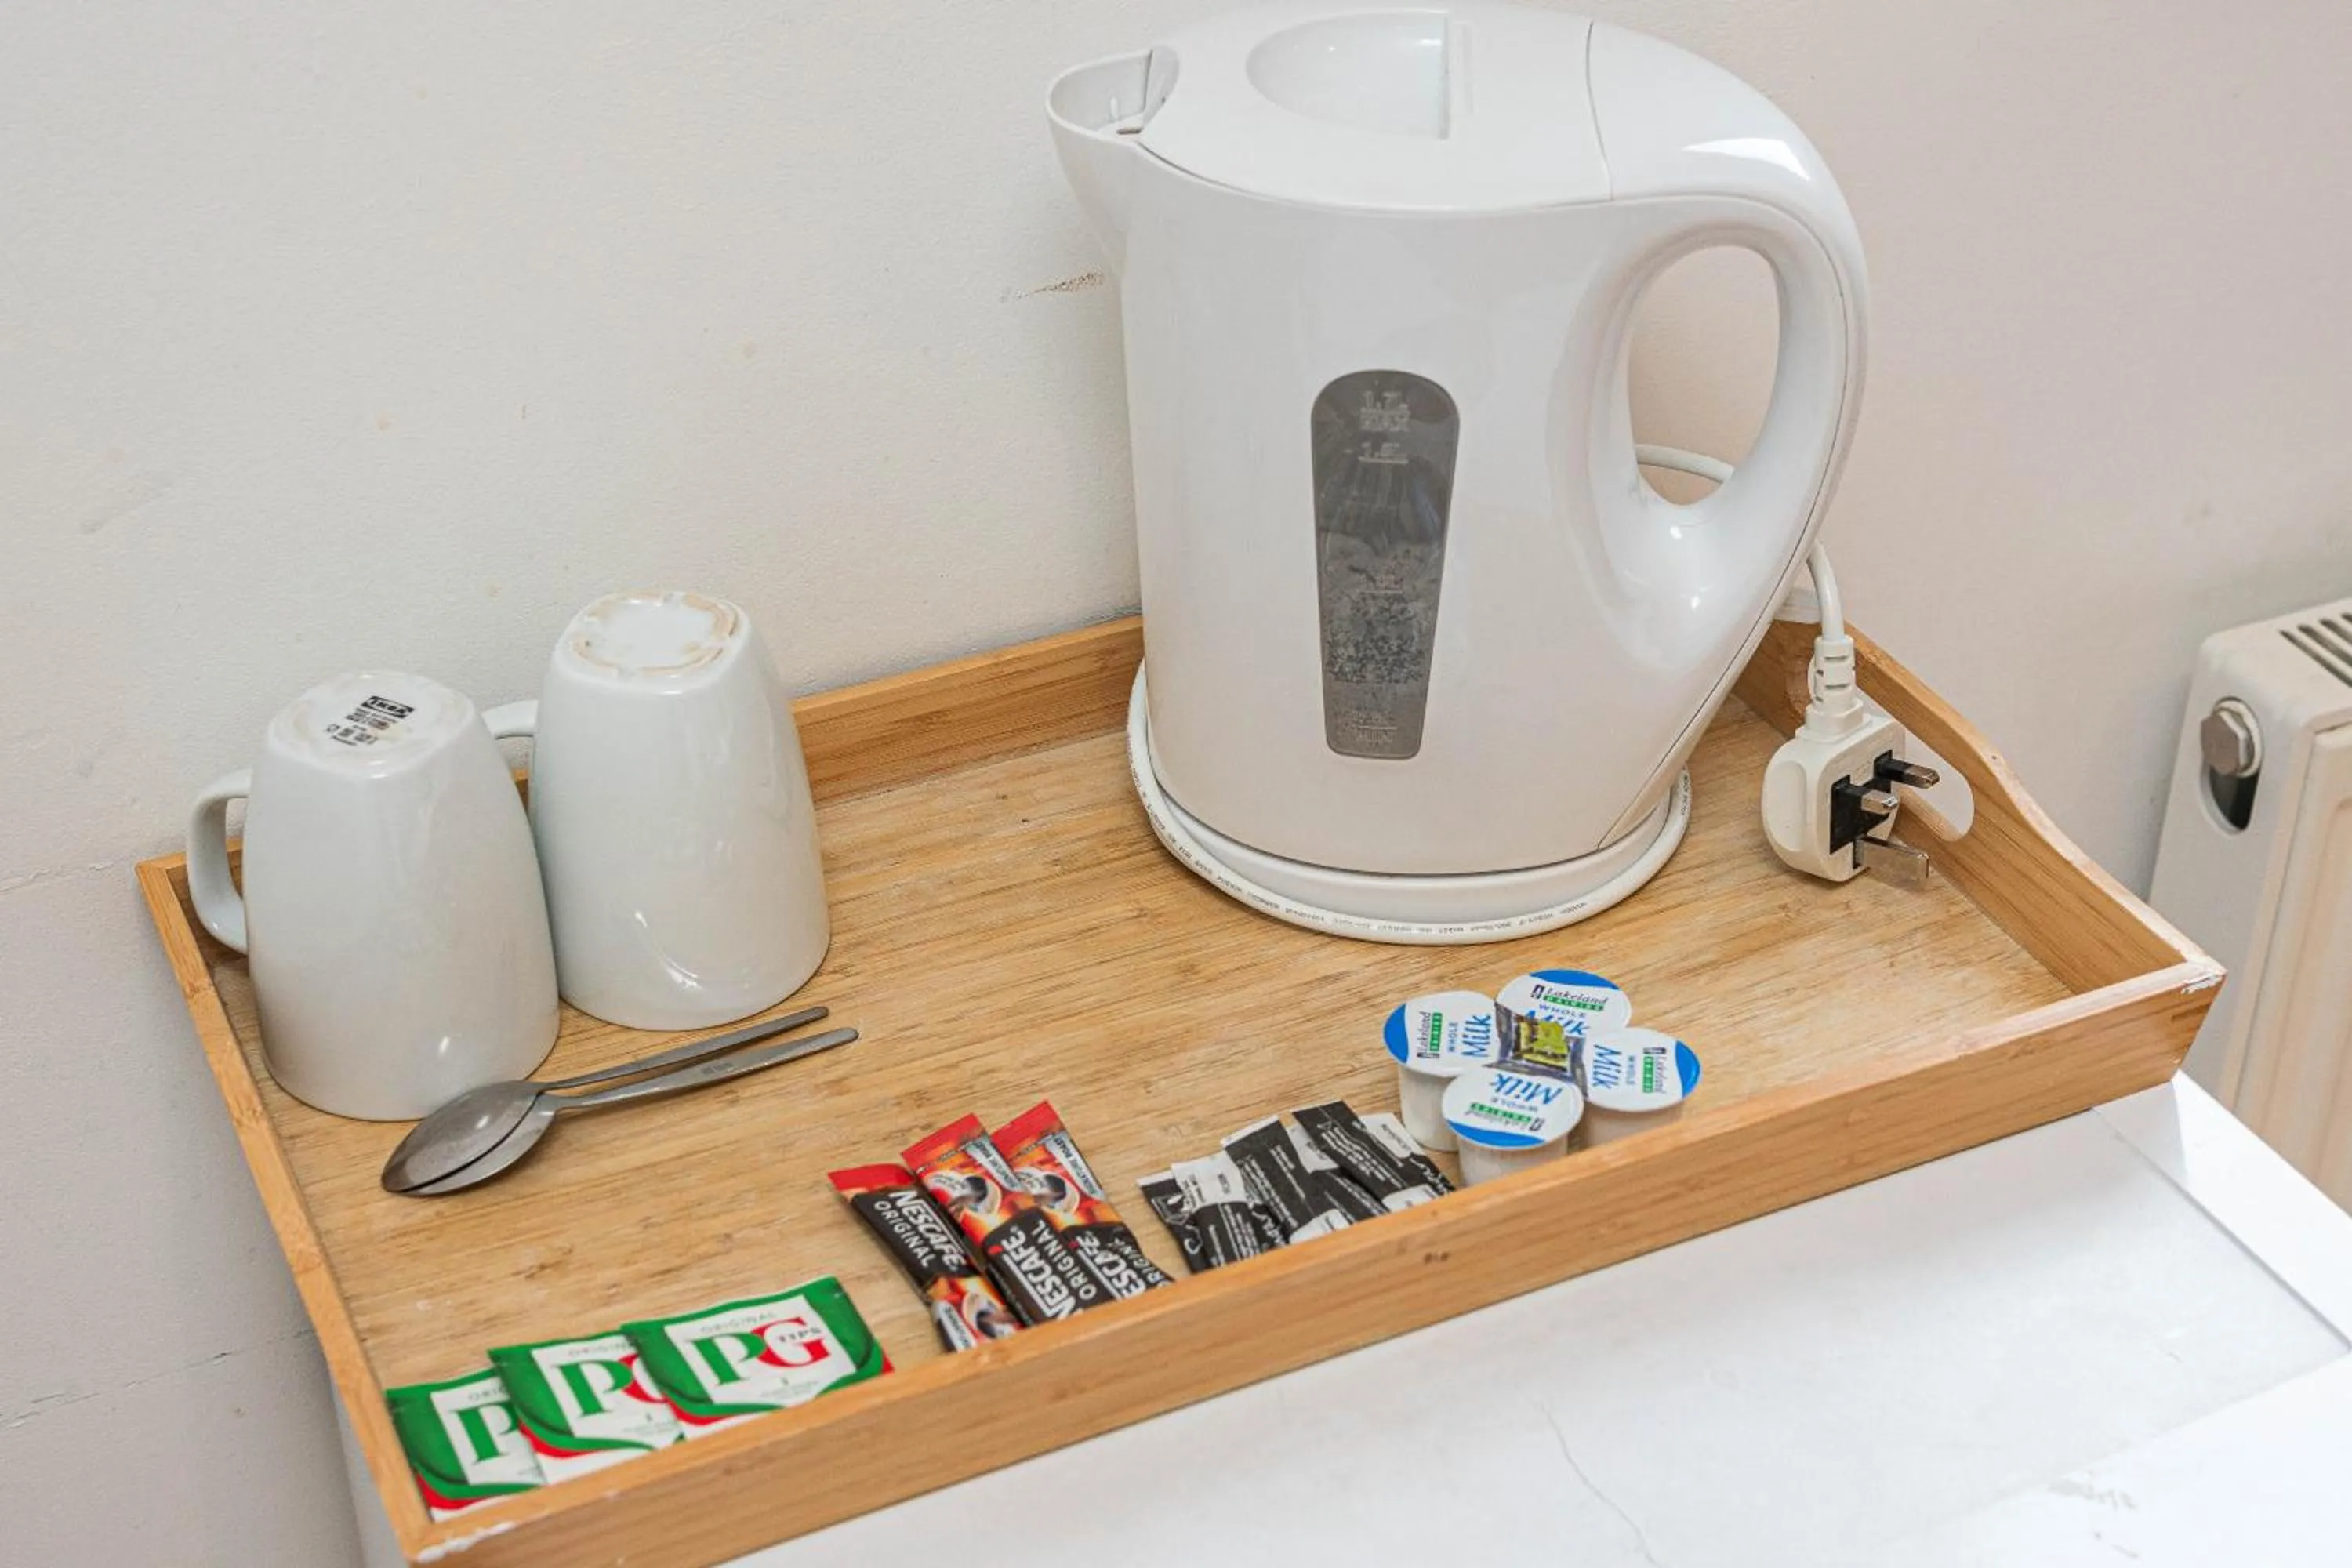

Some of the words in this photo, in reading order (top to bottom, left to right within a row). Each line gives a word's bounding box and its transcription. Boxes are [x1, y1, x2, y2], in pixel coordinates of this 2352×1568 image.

[1539, 1004, 1586, 1018] WHOLE
[1545, 987, 1609, 1004] Lakeland
[1447, 1022, 1458, 1053] WHOLE
[1461, 1014, 1491, 1058] Milk
[1592, 1044, 1622, 1090] Milk
[1489, 1073, 1563, 1105] Milk
[873, 1200, 933, 1269] ORIGINAL
[1034, 1218, 1098, 1301] ORIGINAL
[700, 1312, 777, 1333] ORIGINAL
[778, 1326, 822, 1343] TIPS
[568, 1339, 629, 1356] ORIGIN
[684, 1316, 832, 1386] PG
[448, 1402, 519, 1465] P
